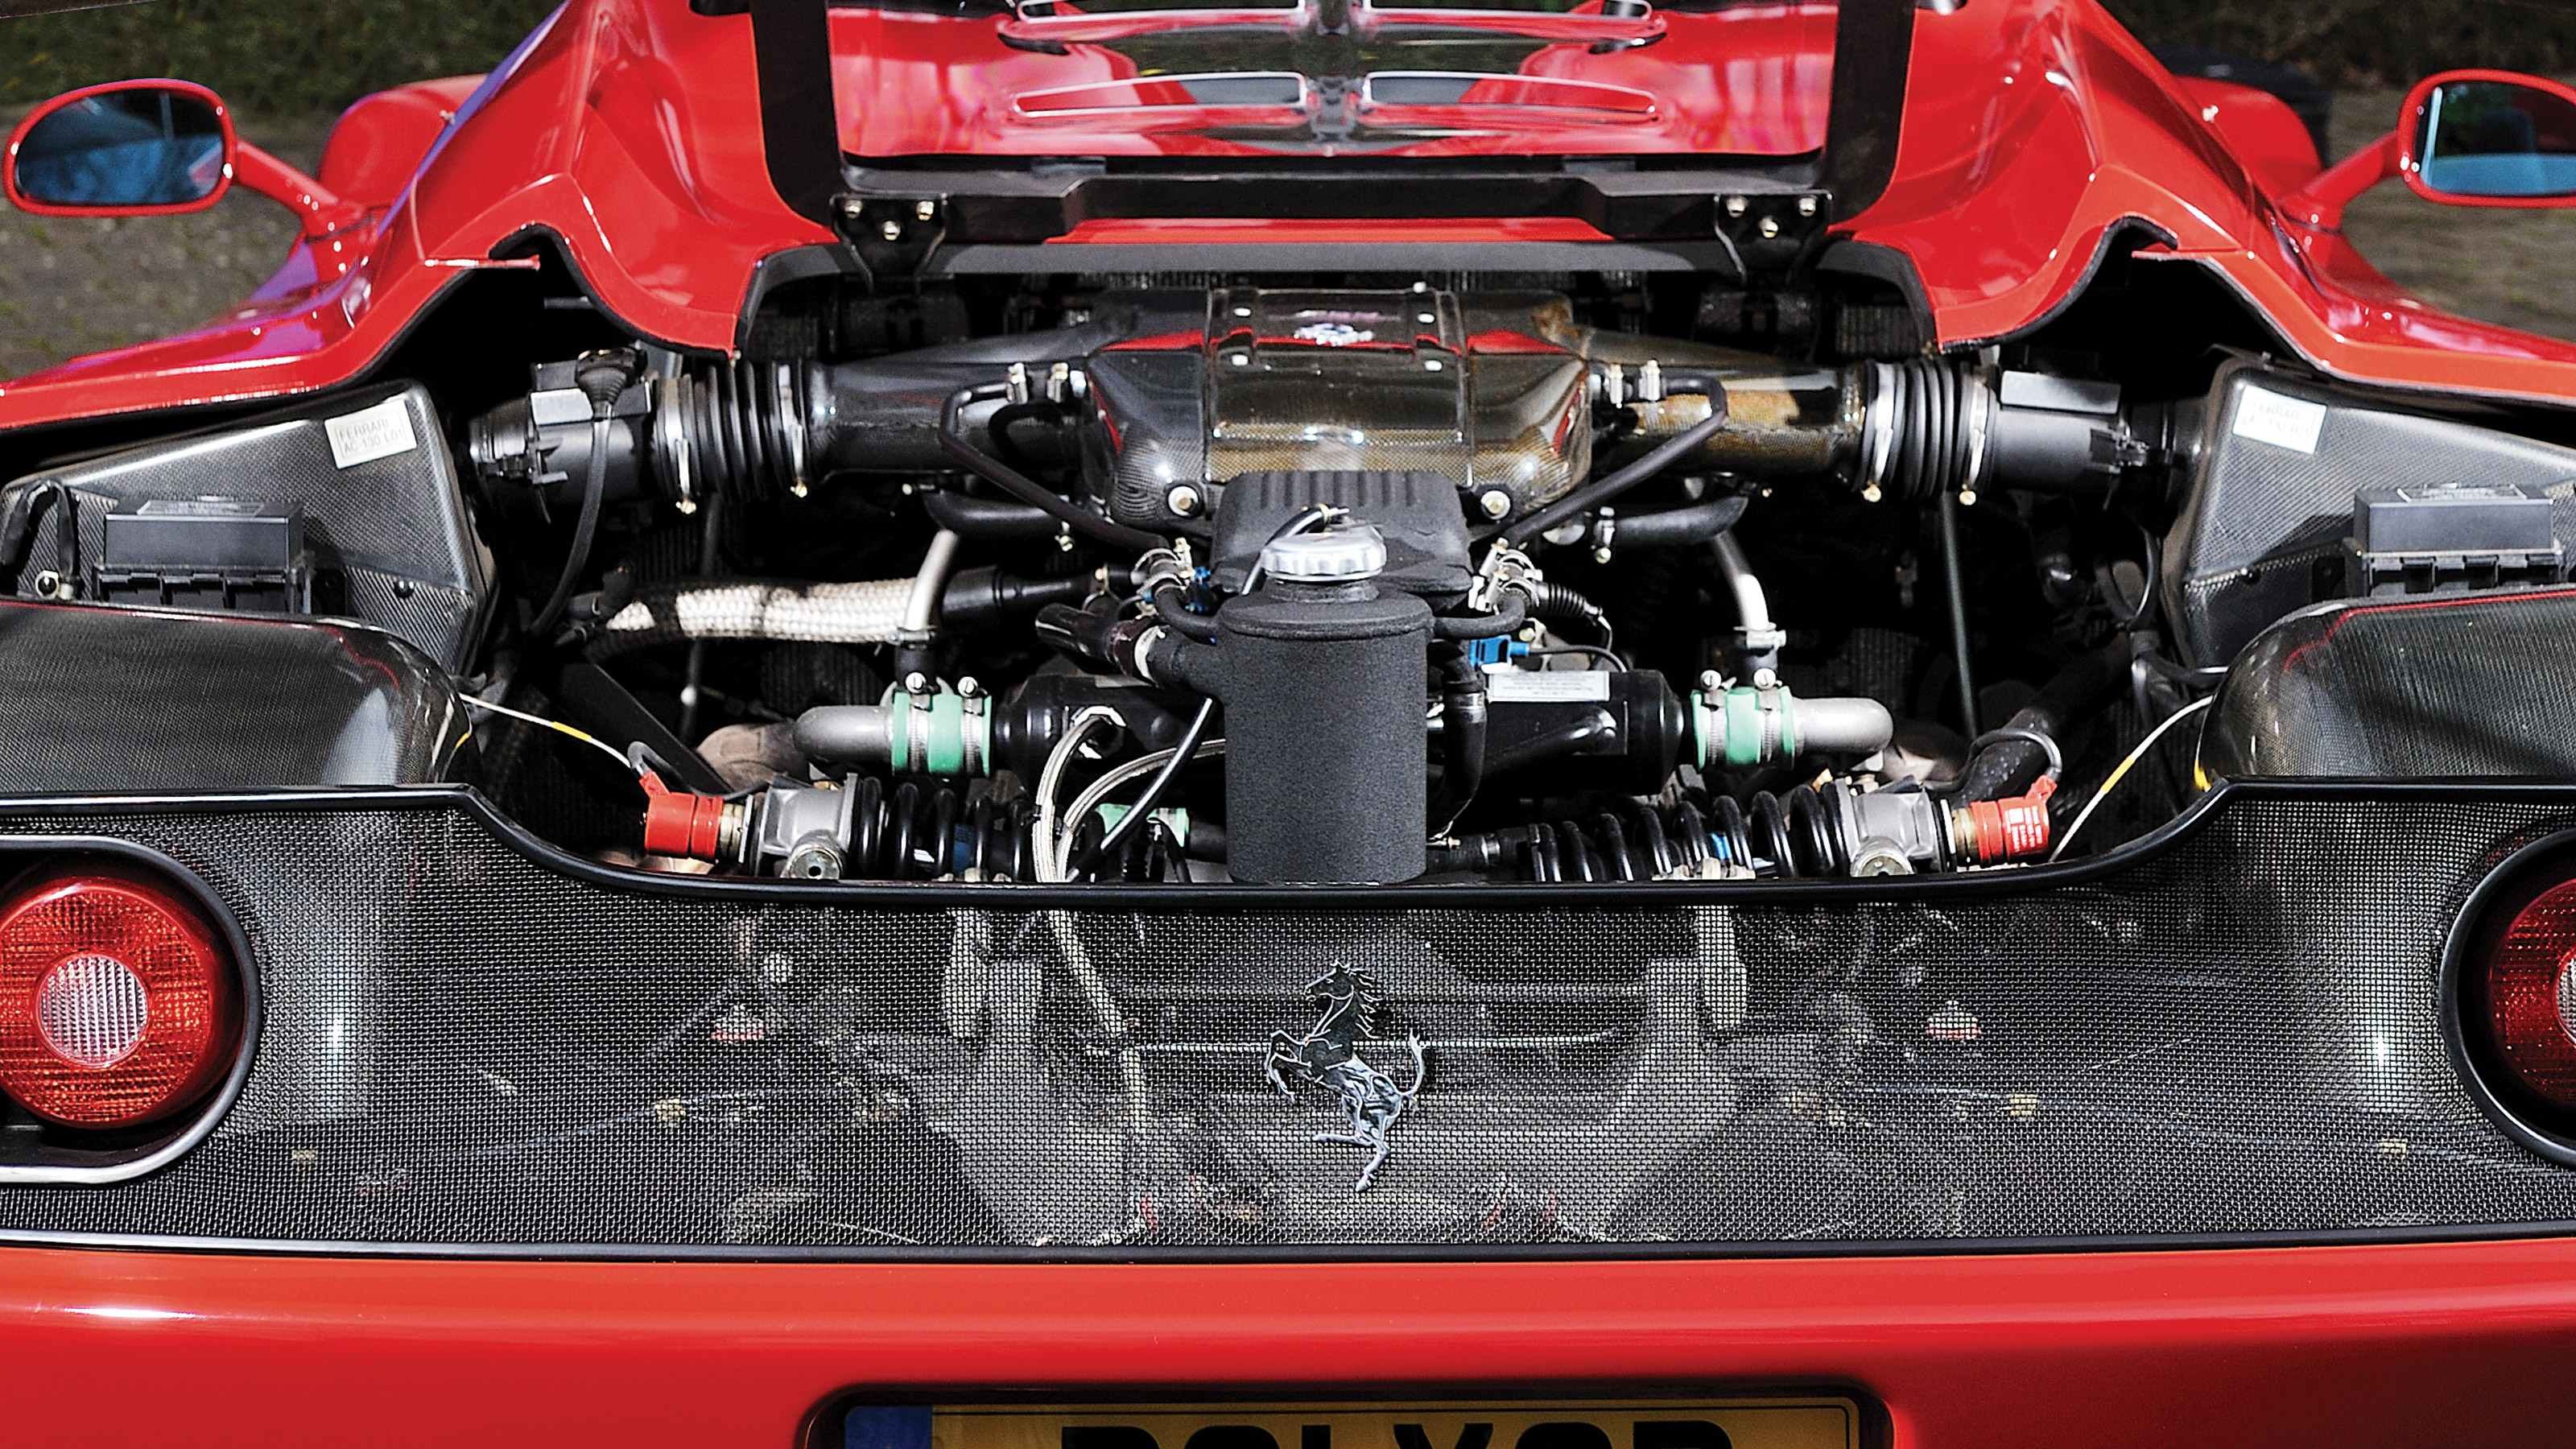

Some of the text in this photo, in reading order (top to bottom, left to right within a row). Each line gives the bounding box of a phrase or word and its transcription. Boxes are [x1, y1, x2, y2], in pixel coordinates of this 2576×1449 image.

[338, 418, 389, 441] FERRARI
[344, 441, 359, 453] AC
[362, 435, 381, 448] 130
